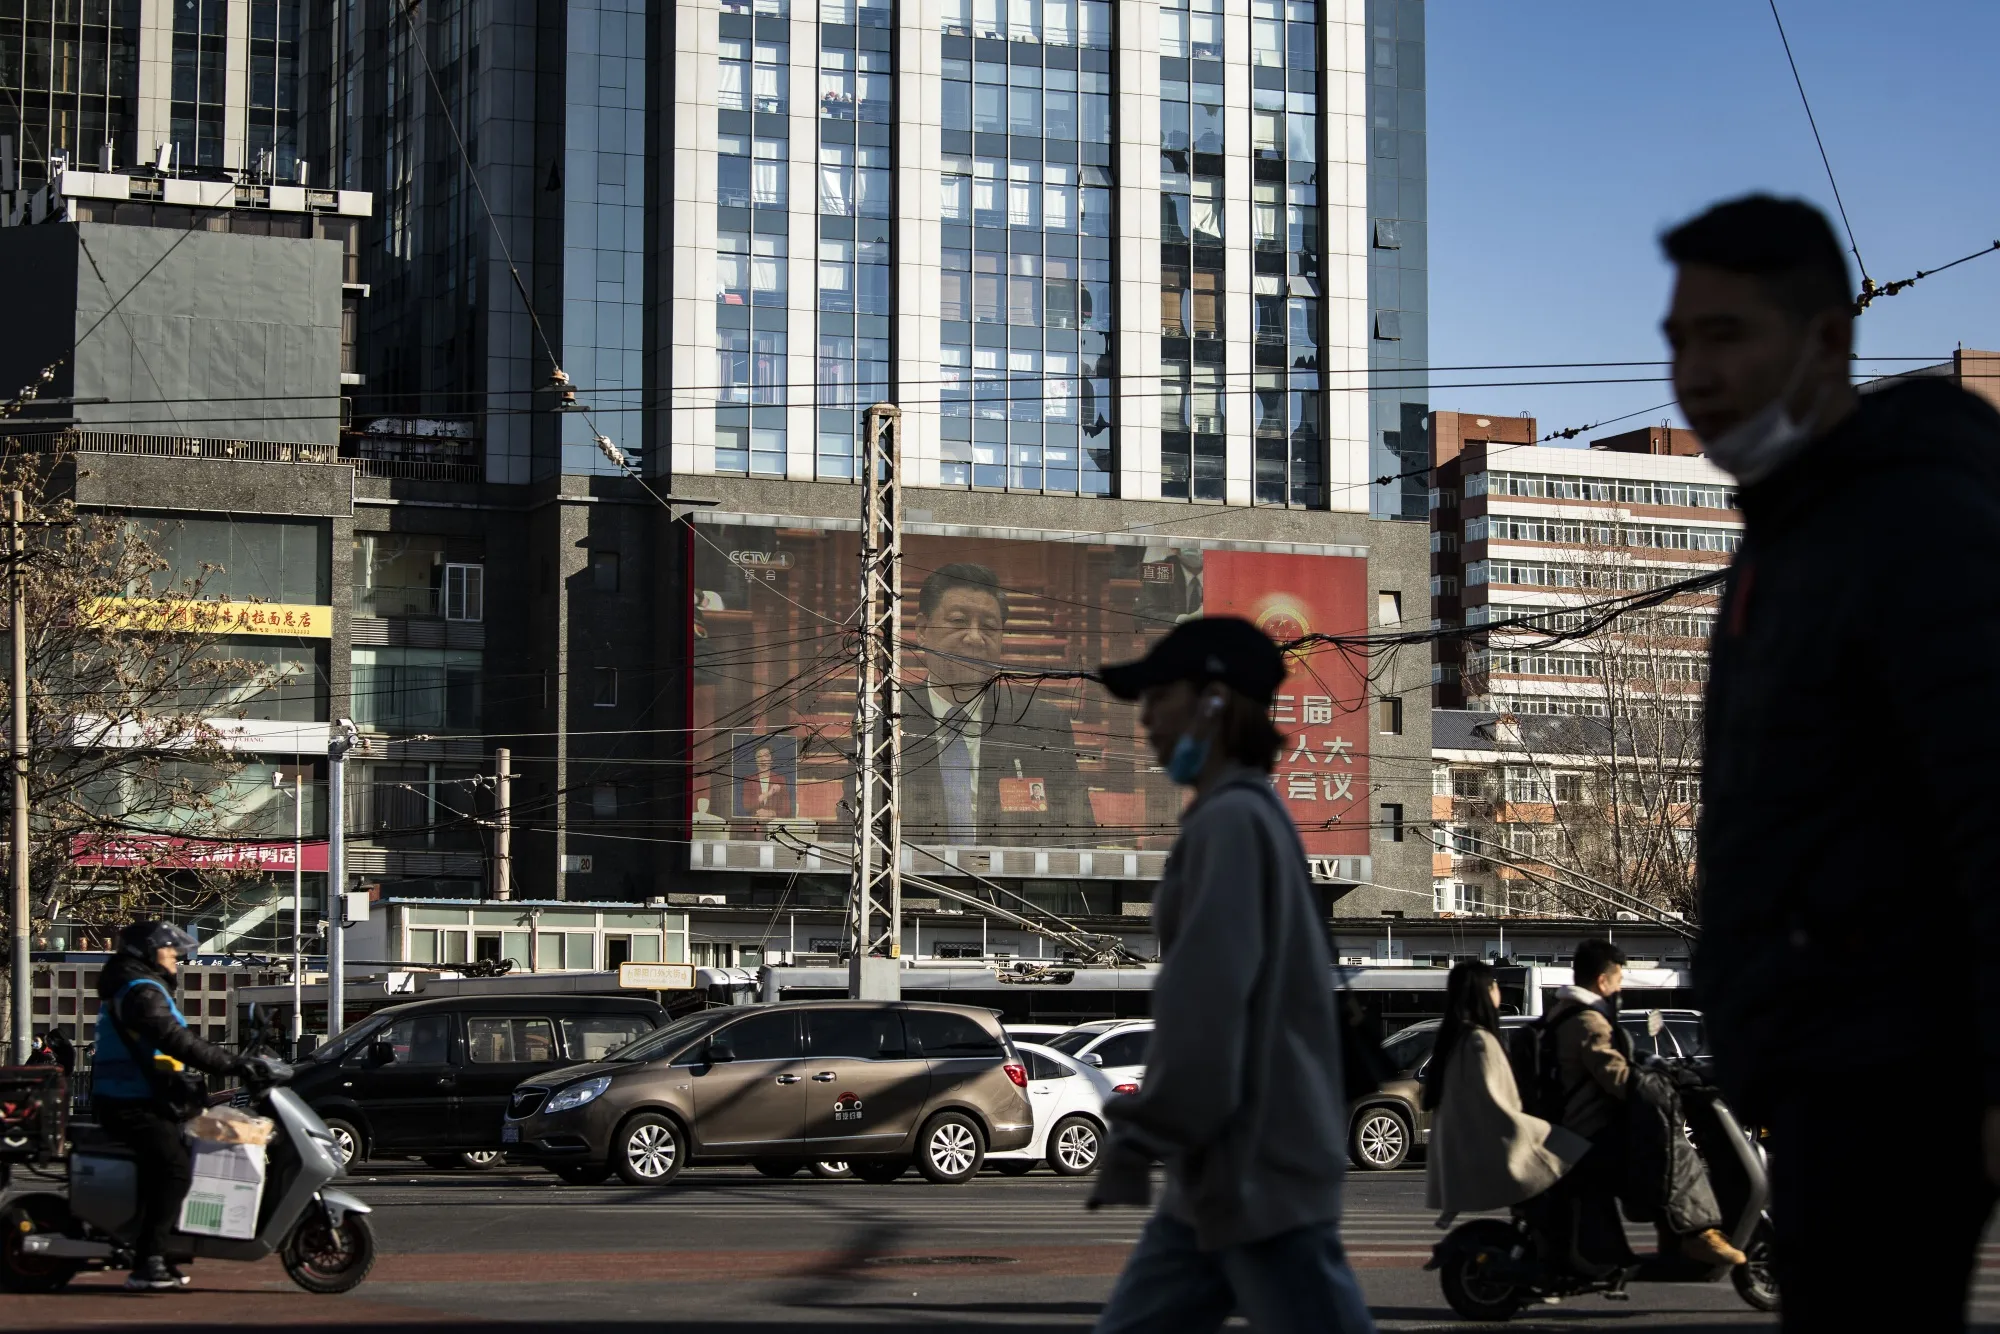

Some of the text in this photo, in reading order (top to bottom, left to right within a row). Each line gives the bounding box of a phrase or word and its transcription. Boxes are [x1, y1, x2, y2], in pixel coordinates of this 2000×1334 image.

[729, 551, 787, 567] CCTV 1
[744, 569, 776, 581] 综合
[1142, 565, 1170, 580] 直播
[1269, 695, 1333, 725] 三届
[580, 858, 591, 870] 20
